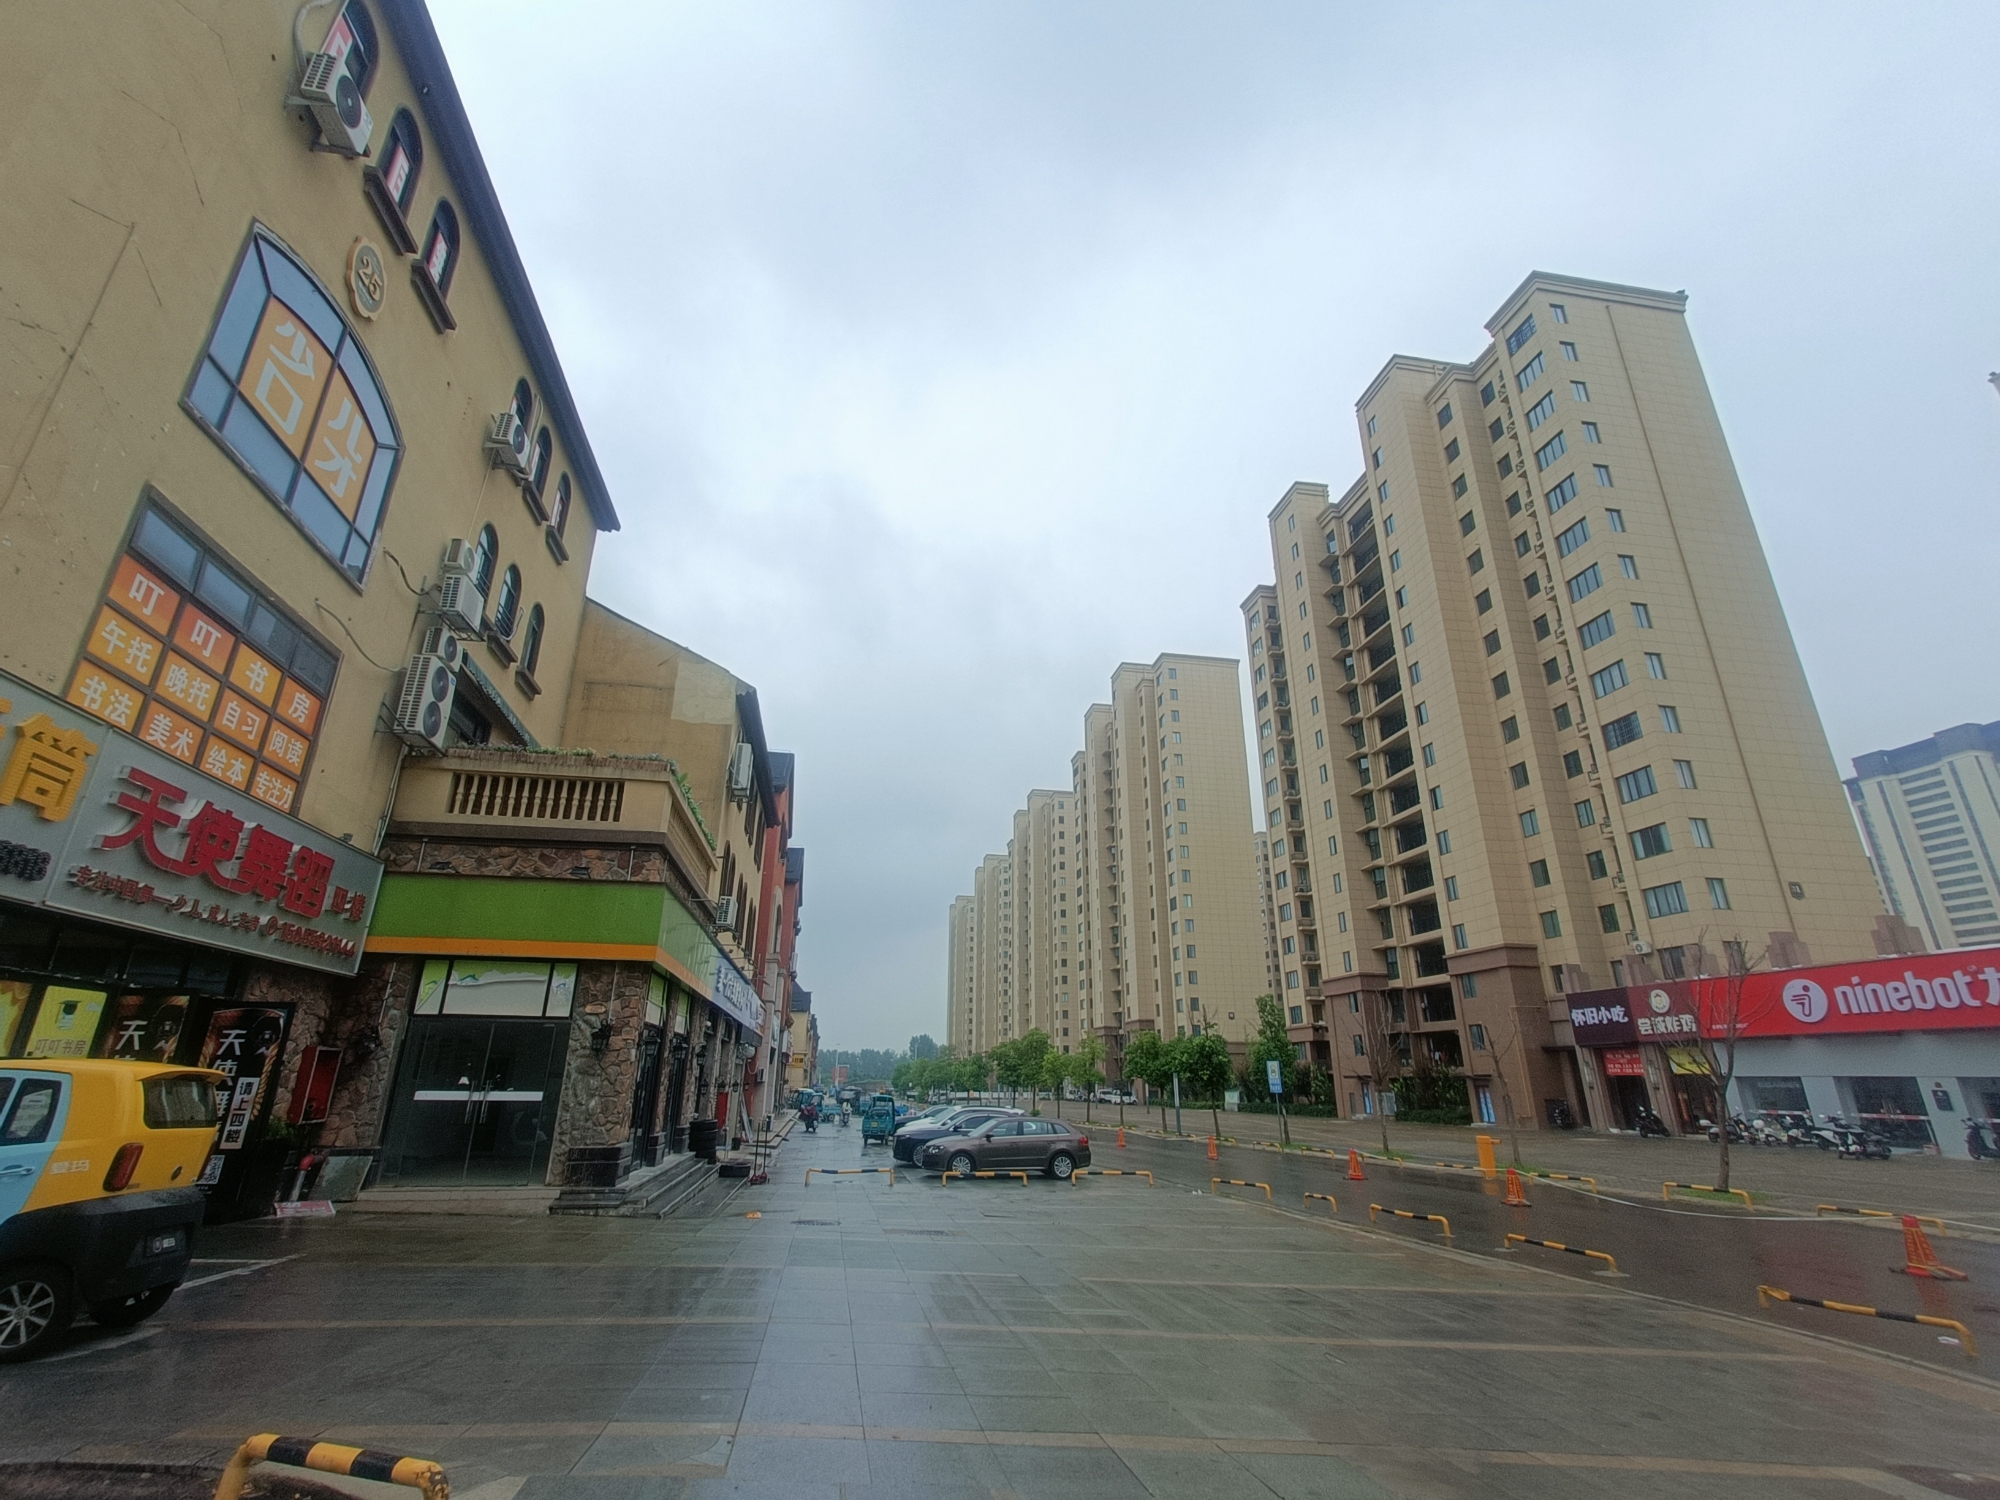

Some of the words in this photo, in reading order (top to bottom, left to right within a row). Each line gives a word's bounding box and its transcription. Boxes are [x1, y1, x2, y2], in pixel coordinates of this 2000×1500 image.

[359, 256, 383, 300] 25
[269, 320, 364, 464] 少儿
[254, 358, 358, 498] 口才
[101, 620, 153, 673] 午托
[164, 663, 211, 711] 晚托
[222, 700, 262, 740] 自习
[269, 729, 304, 768] 阅读
[0, 693, 97, 822] 筒
[80, 675, 134, 726] 书法
[146, 712, 194, 758] 美术
[205, 745, 247, 786] 绘本
[254, 771, 296, 810] 专注力
[332, 886, 367, 921] 四楼
[1571, 1005, 1629, 1027] 怀旧小吃
[1834, 970, 1982, 1014] ninebot
[35, 1037, 87, 1055] 叮叮书房
[223, 1081, 255, 1144] 请上四楼
